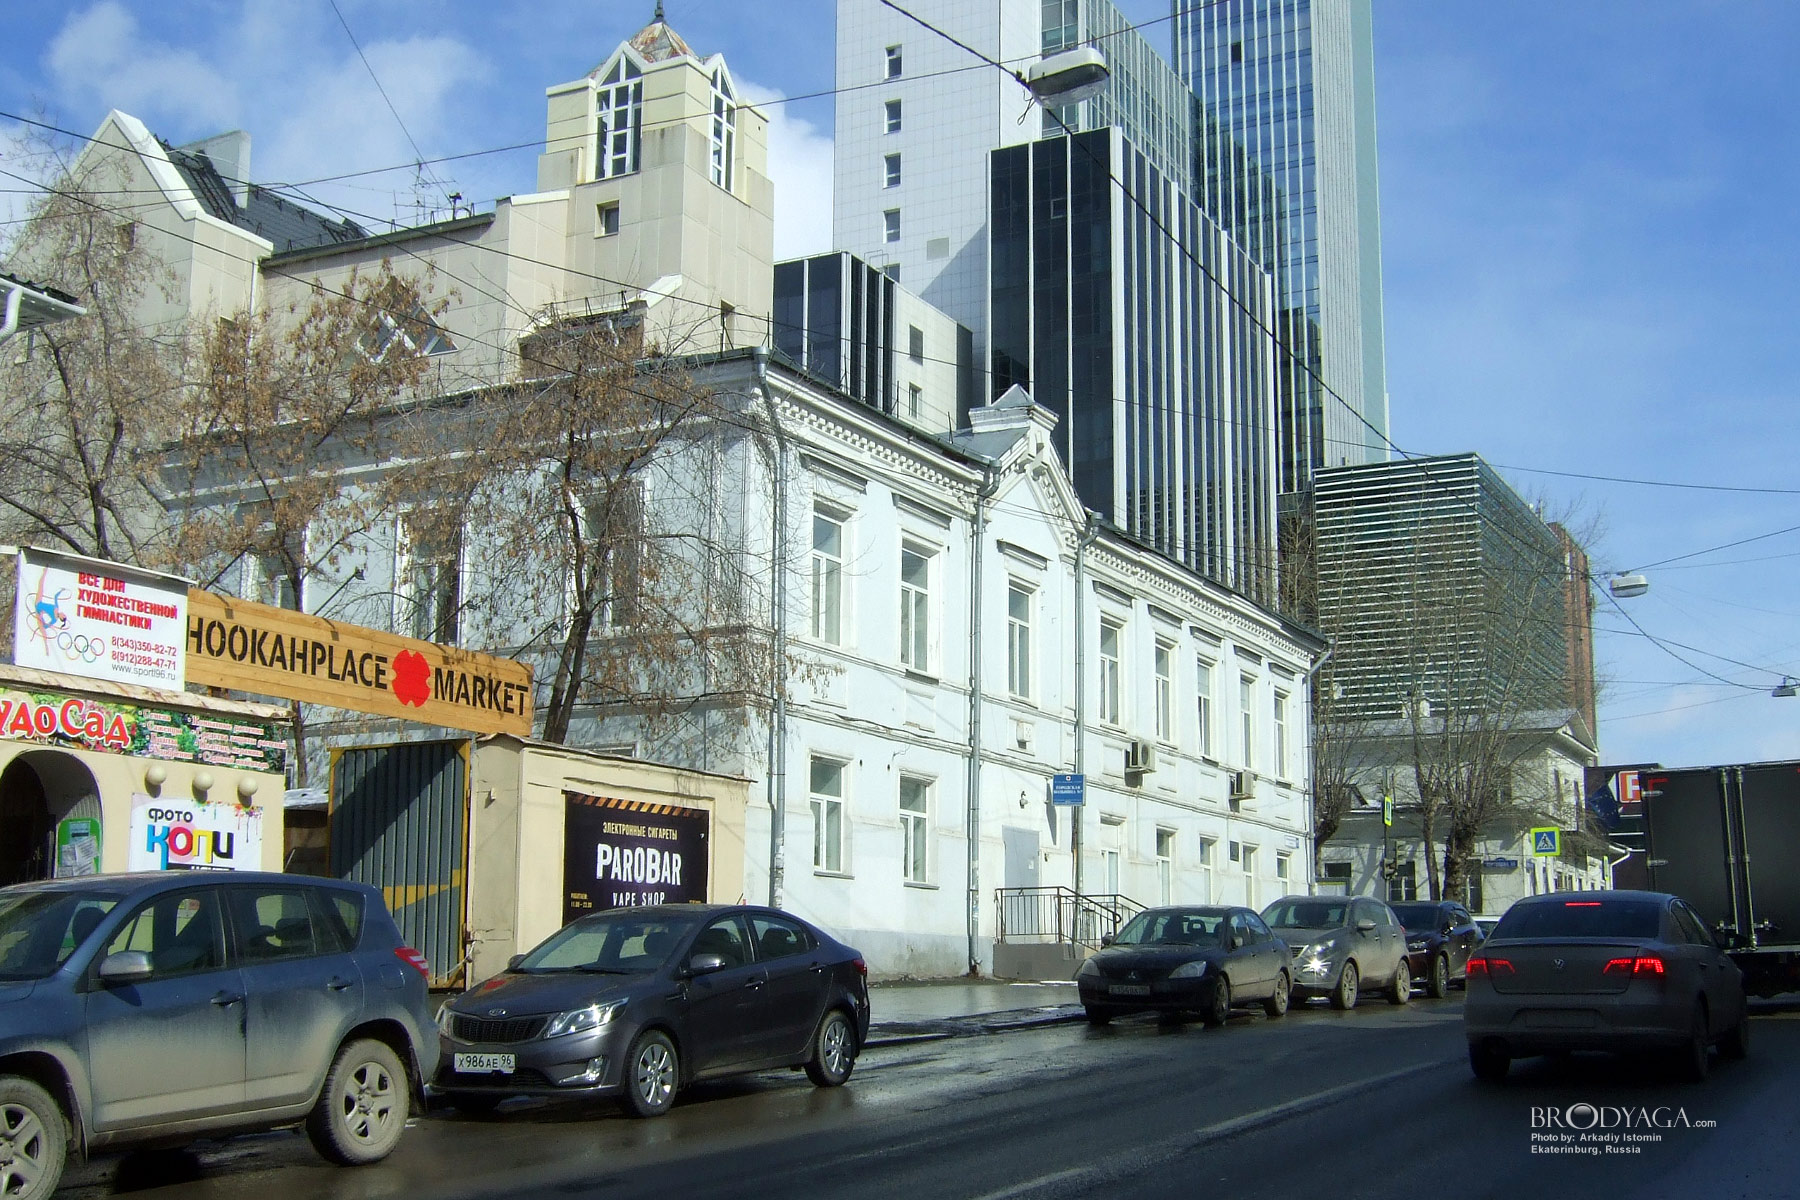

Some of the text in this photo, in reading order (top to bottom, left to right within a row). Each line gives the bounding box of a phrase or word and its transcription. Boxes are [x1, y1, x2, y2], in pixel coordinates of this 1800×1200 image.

[78, 571, 126, 593] ВСЕ ДЛЯ
[77, 587, 178, 620] ХУДОЖЕСТВЕННОЙ
[76, 604, 152, 631] ГИМНАСТИКИ
[186, 615, 529, 716] HOOKAHPLACE MARKET
[602, 821, 678, 841] ЭЛЕКТРОННЫЕ СИГАРЕТЫ
[612, 892, 666, 907] VAPE SHOP
[501, 1056, 512, 1066] 96
